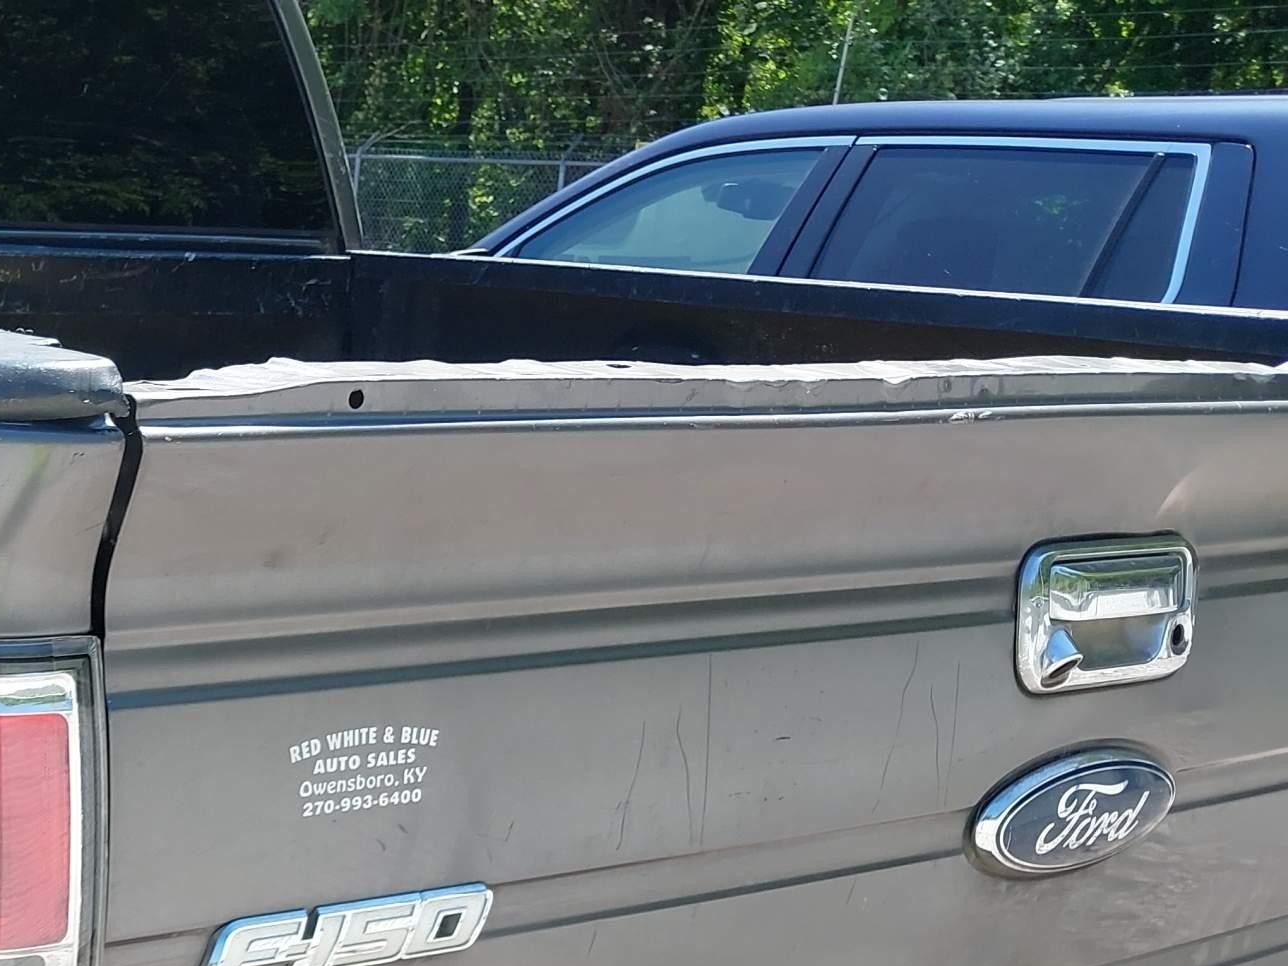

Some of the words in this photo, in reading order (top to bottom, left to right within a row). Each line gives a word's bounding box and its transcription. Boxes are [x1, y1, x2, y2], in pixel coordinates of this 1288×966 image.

[289, 738, 321, 763] RED
[326, 726, 378, 751] WHITE
[383, 726, 395, 743] &
[401, 726, 440, 747] BLUE
[313, 755, 361, 774] AUTO
[366, 748, 416, 768] SALES
[299, 773, 400, 797] Owensboro,
[403, 766, 428, 784] KY
[302, 788, 422, 817] 270-993-6400
[1035, 779, 1150, 855] Ford
